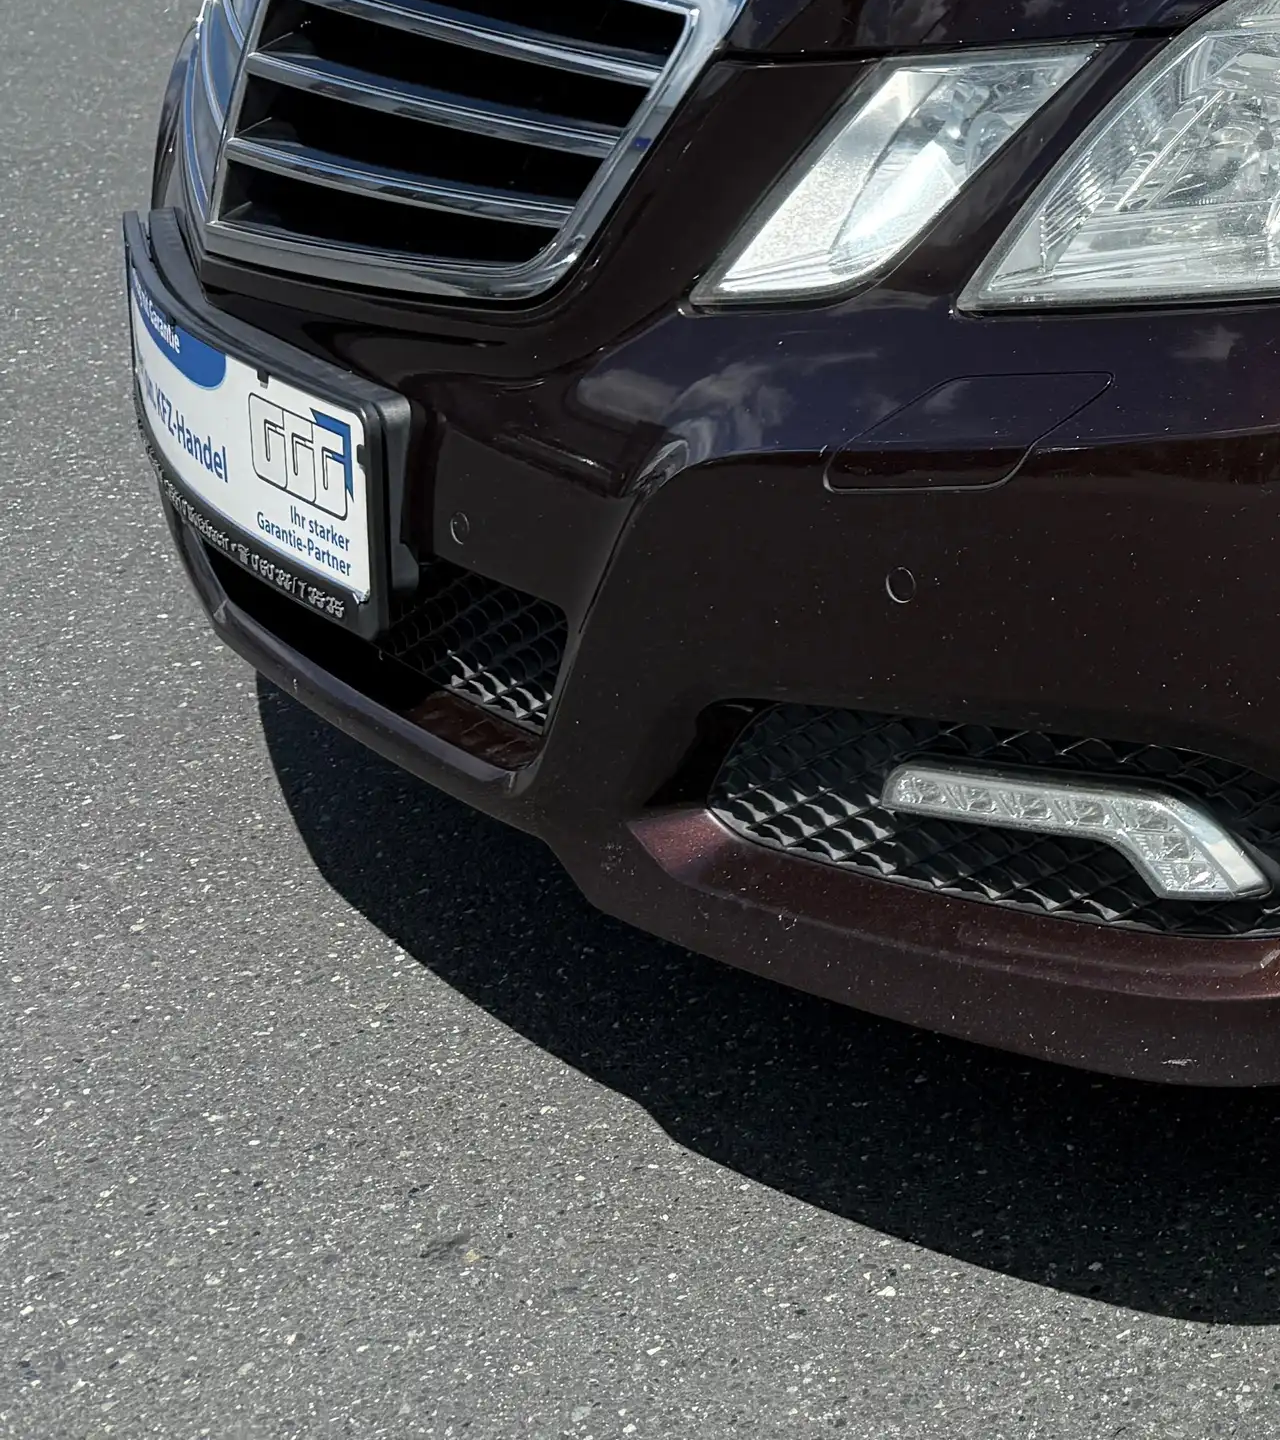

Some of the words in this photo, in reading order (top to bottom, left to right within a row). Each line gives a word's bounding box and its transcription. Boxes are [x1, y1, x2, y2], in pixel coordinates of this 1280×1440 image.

[155, 382, 229, 483] KFZ-Handel
[256, 510, 352, 578] Garantie-Partner
[289, 504, 306, 527] Ihr
[308, 517, 351, 553] starker
